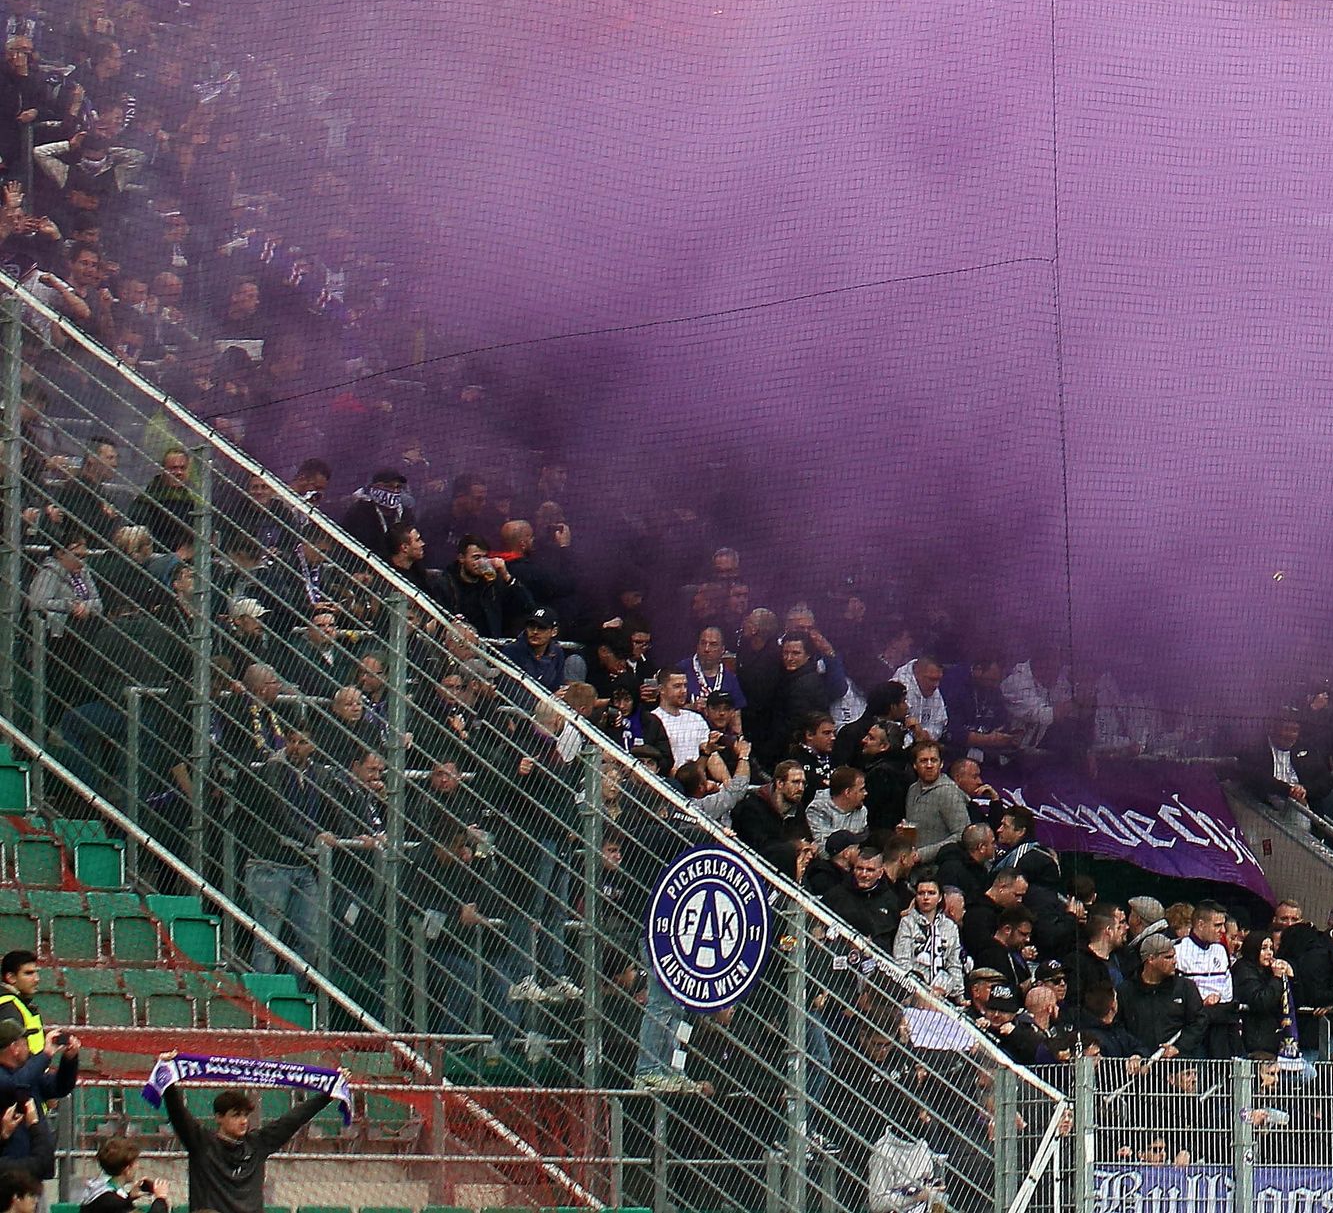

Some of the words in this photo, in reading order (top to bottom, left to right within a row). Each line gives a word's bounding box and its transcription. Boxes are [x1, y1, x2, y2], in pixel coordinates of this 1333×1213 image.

[656, 917, 669, 933] 19
[749, 925, 761, 941] 11
[660, 953, 710, 1000] AUSTRIA
[714, 960, 750, 997] WIEN
